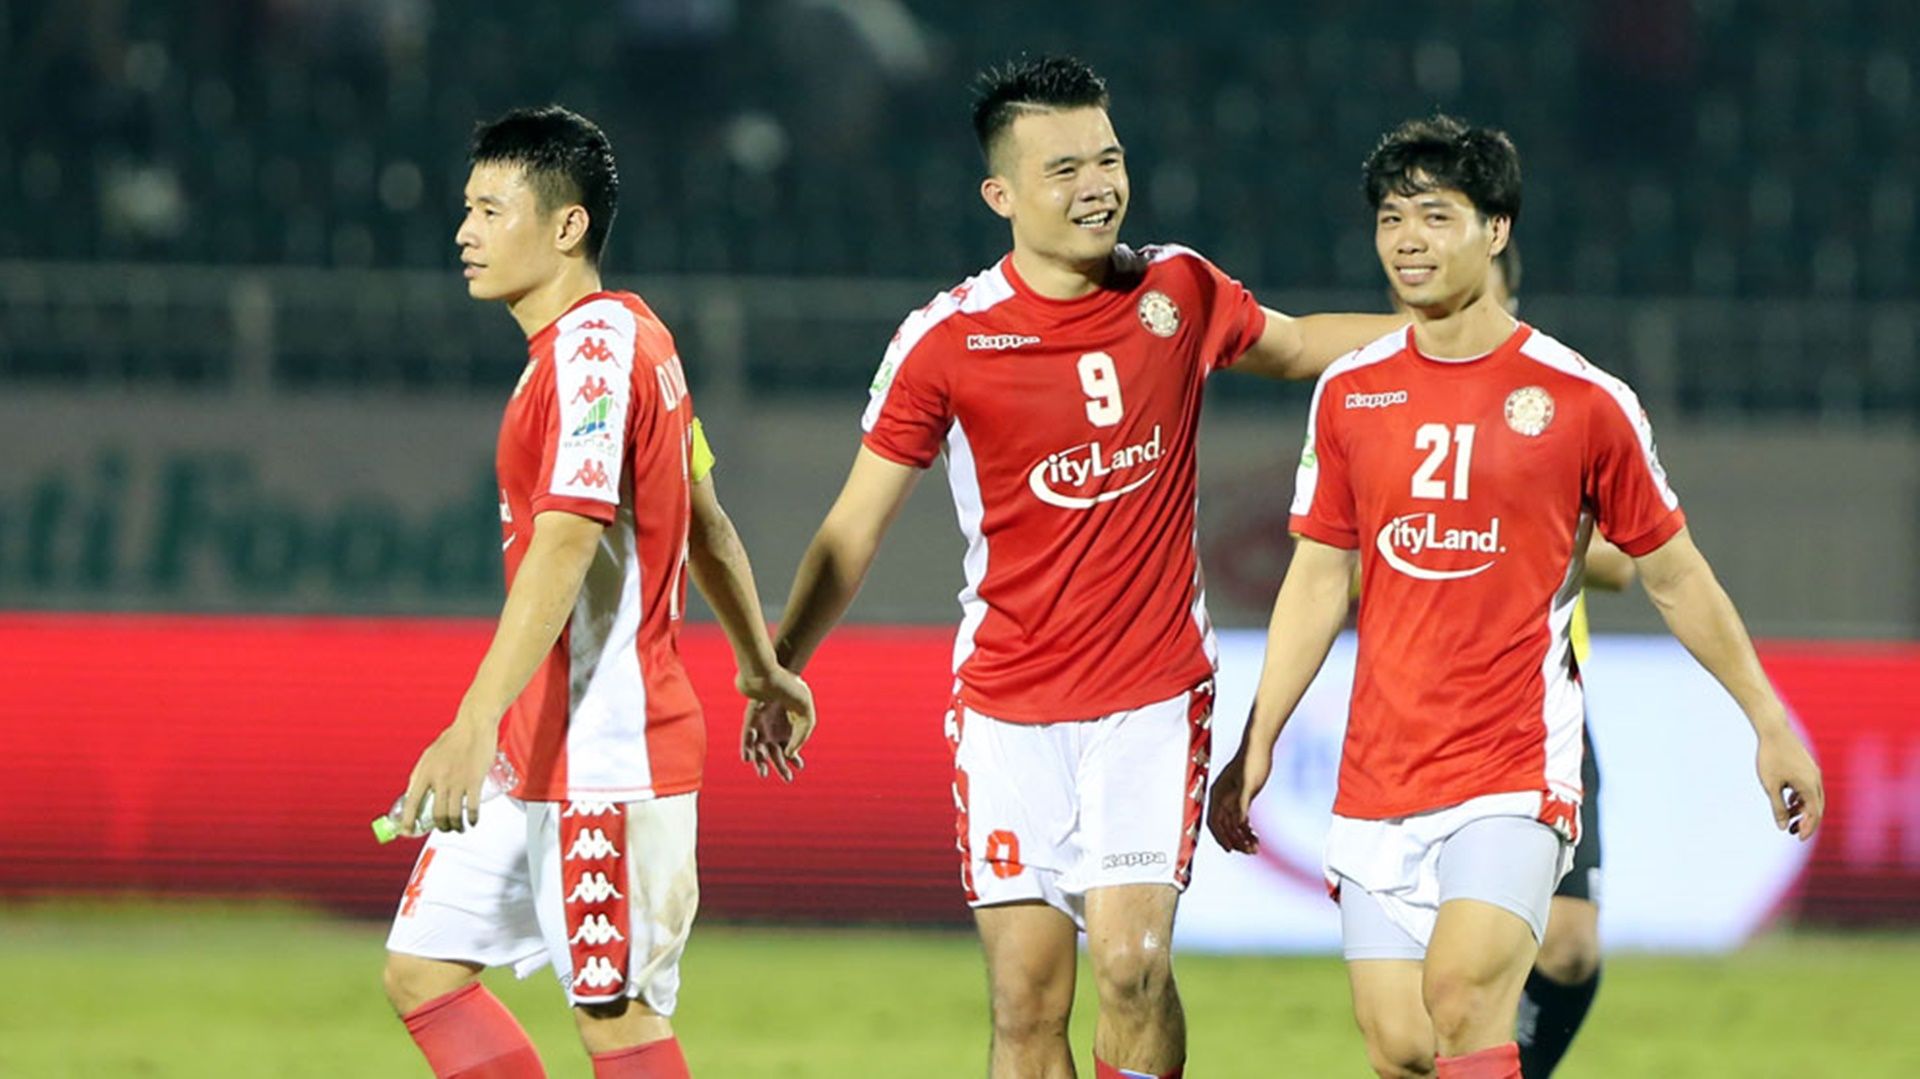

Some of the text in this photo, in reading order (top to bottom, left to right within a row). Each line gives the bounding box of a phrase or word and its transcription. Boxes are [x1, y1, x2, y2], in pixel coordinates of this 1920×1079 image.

[1077, 352, 1124, 428] 9
[1345, 390, 1408, 409] Kappa
[1411, 423, 1476, 501] 21
[1102, 852, 1168, 870] Kappa
